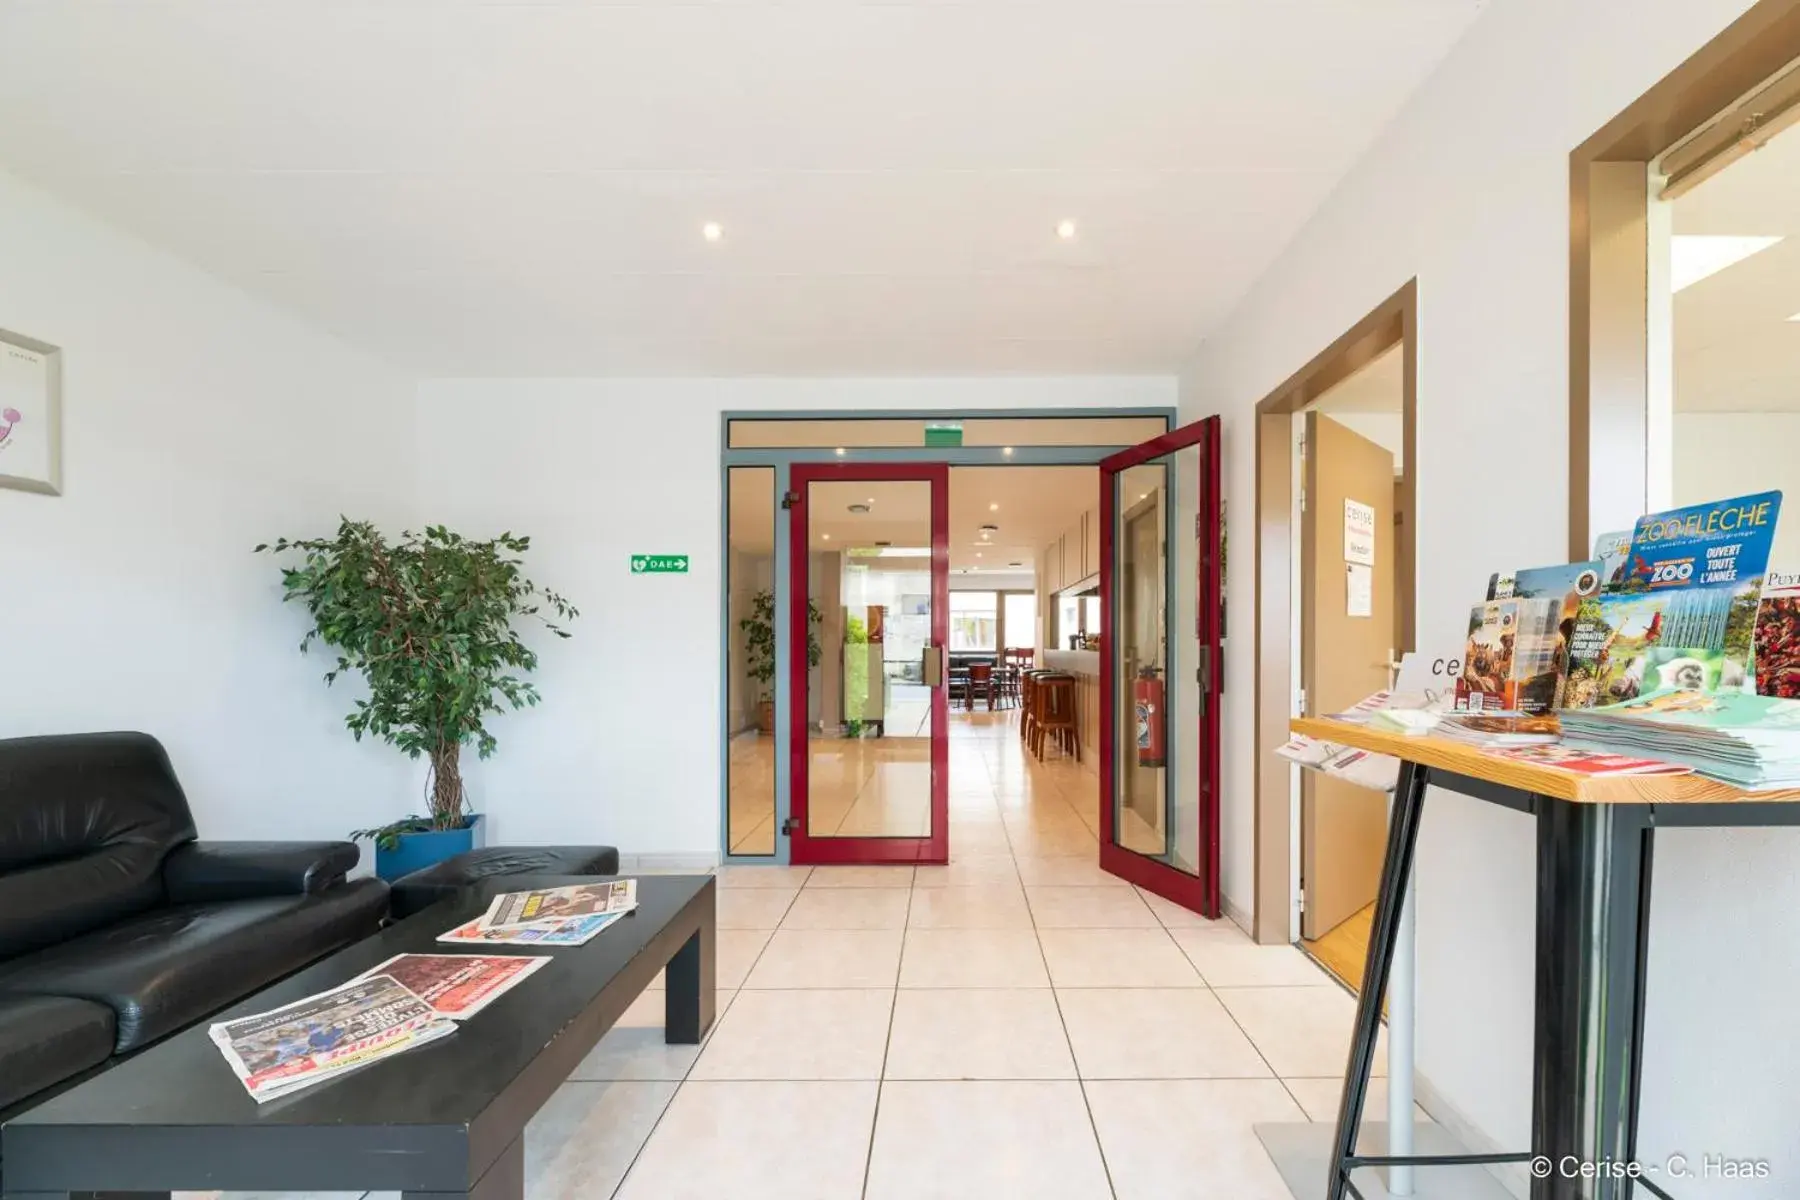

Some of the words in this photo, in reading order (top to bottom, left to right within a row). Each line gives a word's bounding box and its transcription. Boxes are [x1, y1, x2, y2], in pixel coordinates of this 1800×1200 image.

[1706, 544, 1742, 559] OUVERT
[650, 560, 673, 569] DAE
[1707, 558, 1736, 571] TOUTE
[1651, 563, 1694, 583] ZOO
[1432, 658, 1460, 676] ce
